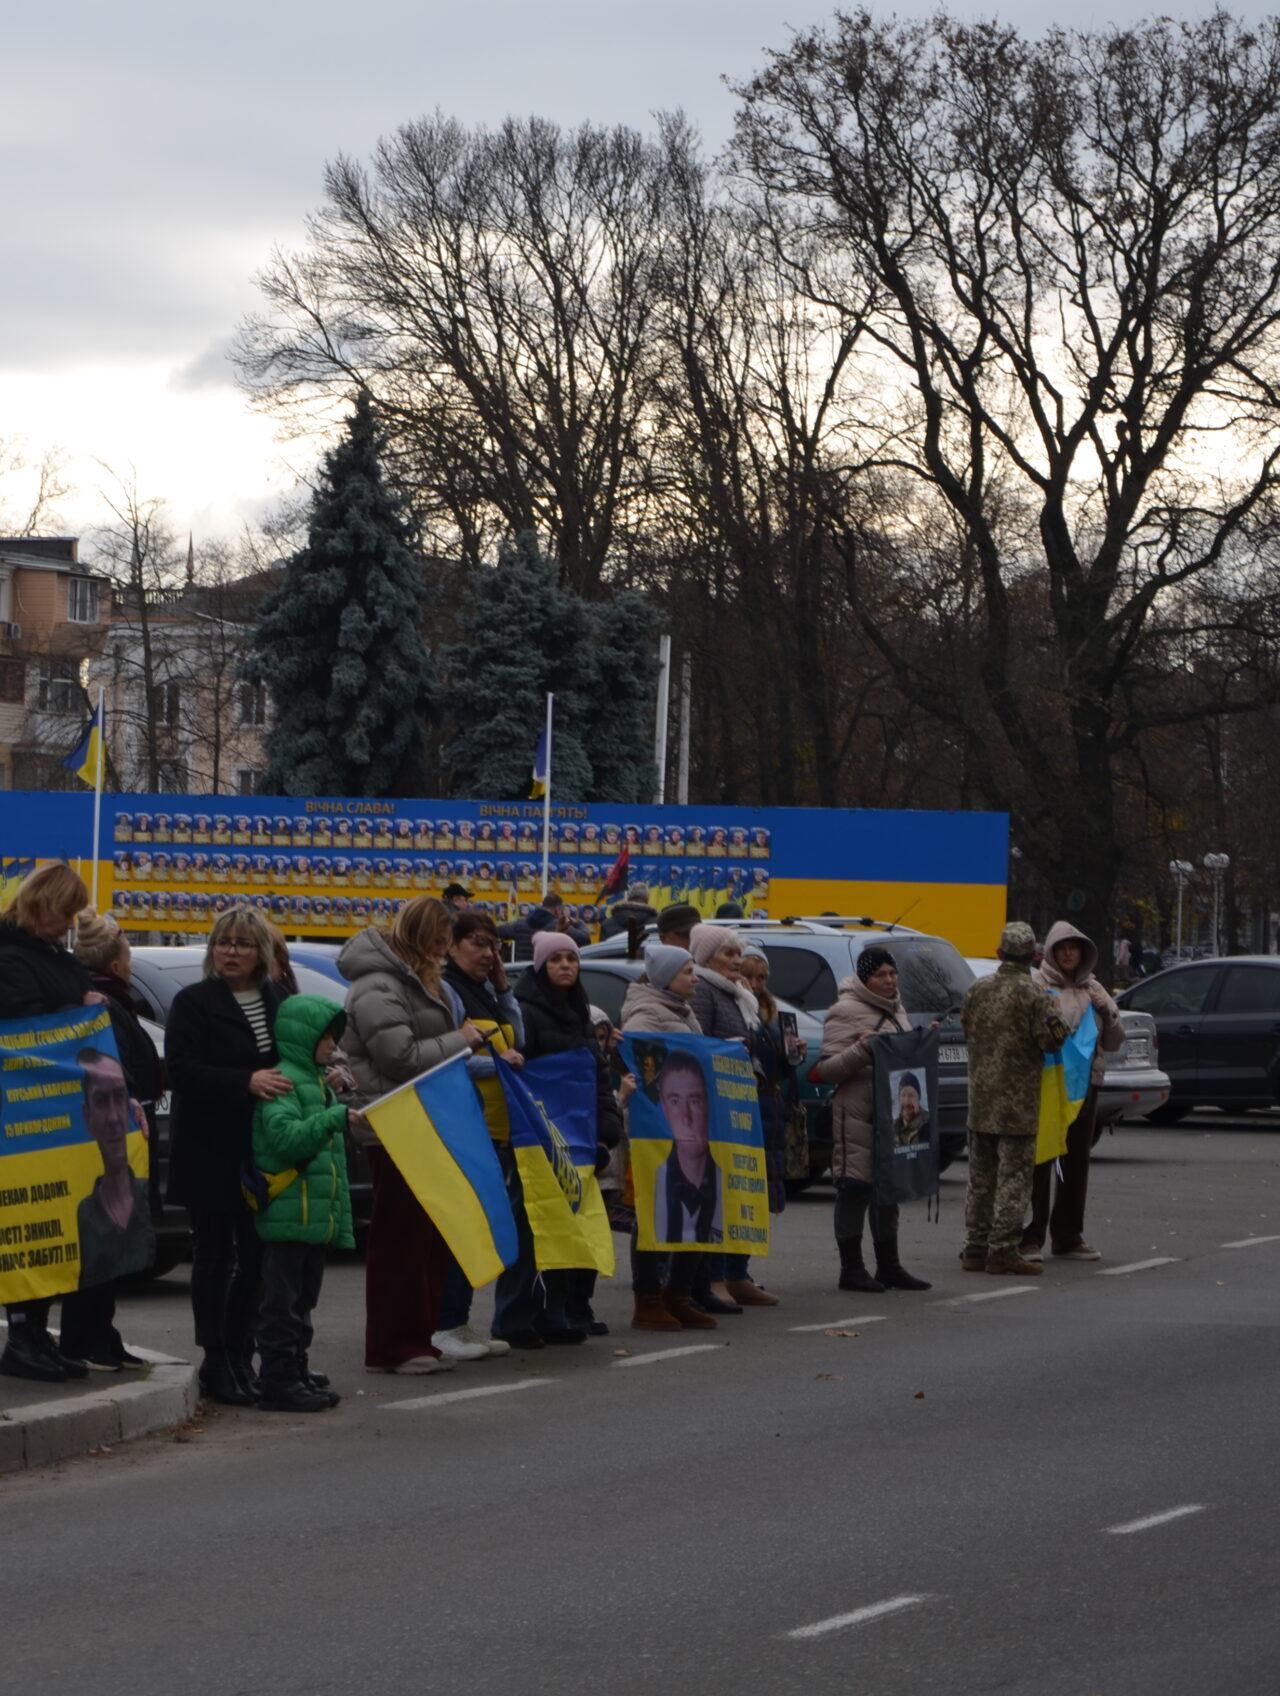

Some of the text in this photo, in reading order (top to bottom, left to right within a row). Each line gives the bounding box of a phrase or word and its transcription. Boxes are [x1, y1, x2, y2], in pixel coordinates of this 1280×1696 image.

[305, 801, 396, 815] ВІЧНА СЛАВА!
[480, 805, 520, 817] ВІЧНА
